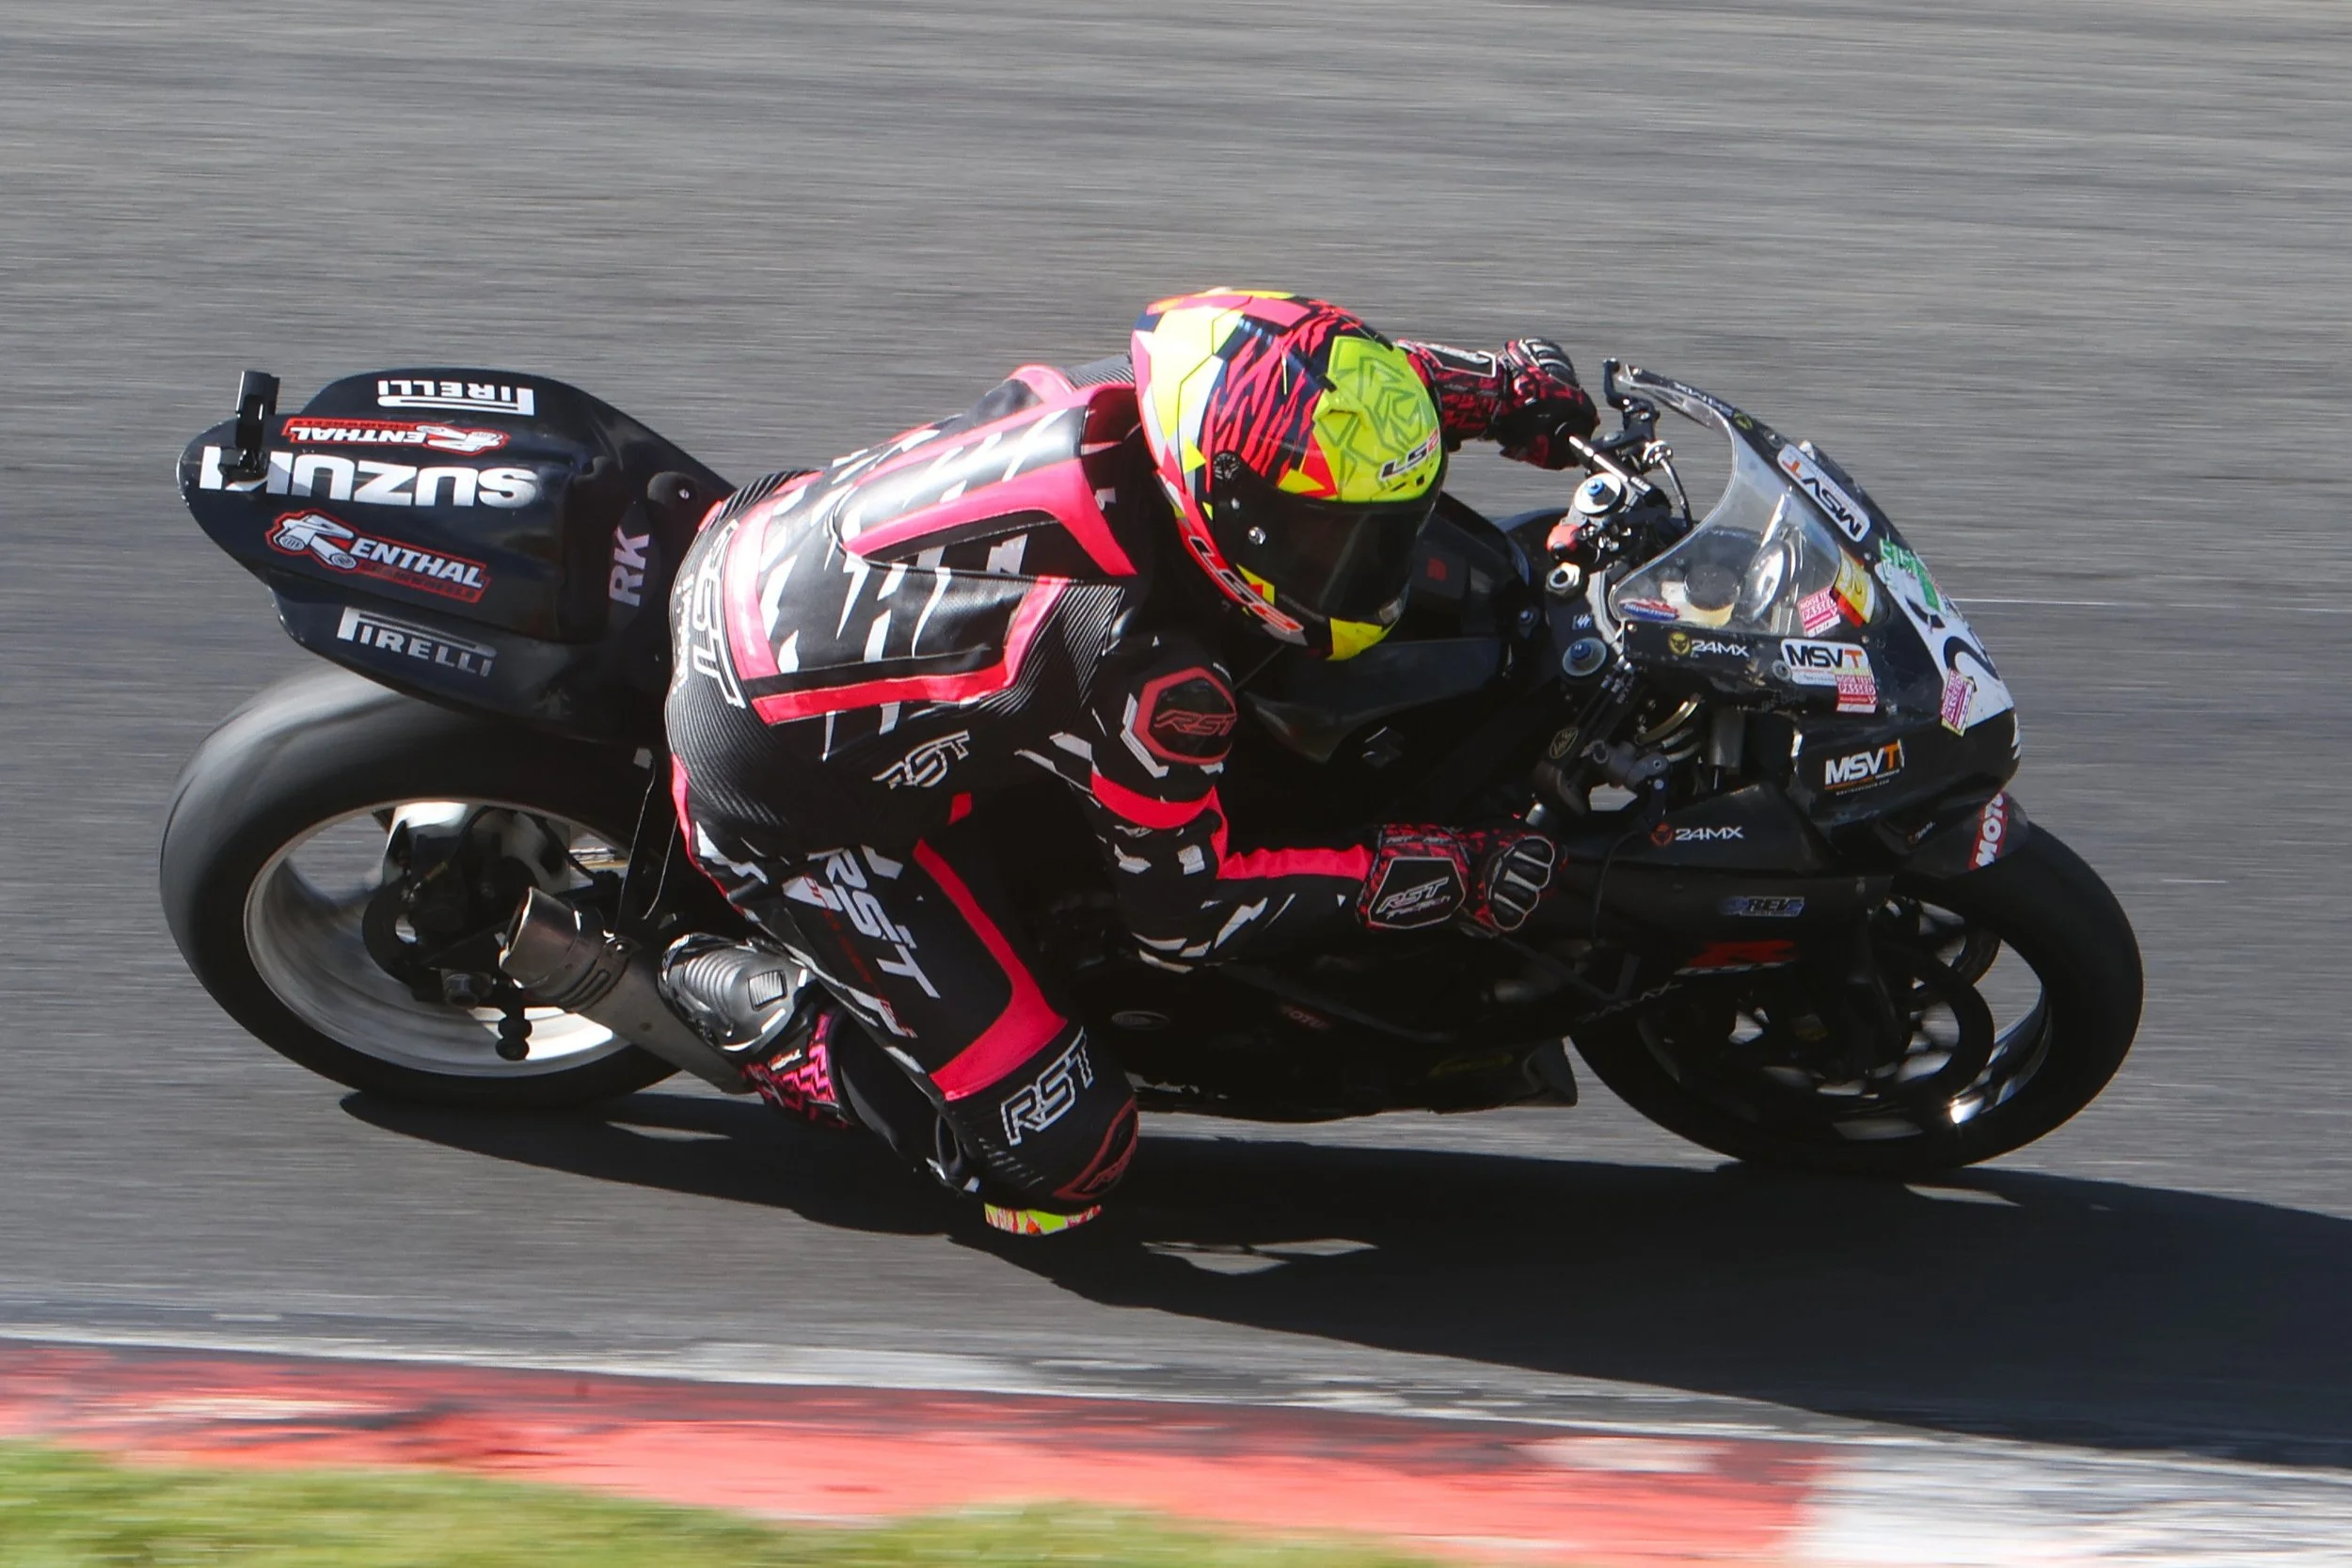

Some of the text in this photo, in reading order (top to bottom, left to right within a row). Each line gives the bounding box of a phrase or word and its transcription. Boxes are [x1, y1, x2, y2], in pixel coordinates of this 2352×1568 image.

[377, 380, 533, 416] PIRELLI
[290, 424, 505, 453] RENTHAL
[1378, 427, 1440, 482] LS2
[1782, 459, 1863, 538] MSVT
[274, 515, 485, 589] RENTHAL
[609, 525, 650, 608] RK
[1189, 535, 1305, 635] LS2
[1803, 600, 1836, 622] PASSED
[337, 607, 497, 677] PIRELLI
[1692, 640, 1750, 657] 24MX
[1786, 644, 1863, 668] MSVT
[1839, 684, 1876, 696] PASSED
[1153, 708, 1237, 736] RST
[1824, 741, 1899, 785] MSVT
[1675, 825, 1745, 842] 24MX
[1375, 876, 1450, 915] RST
[825, 848, 941, 999] RST
[1000, 1026, 1094, 1147] RST
